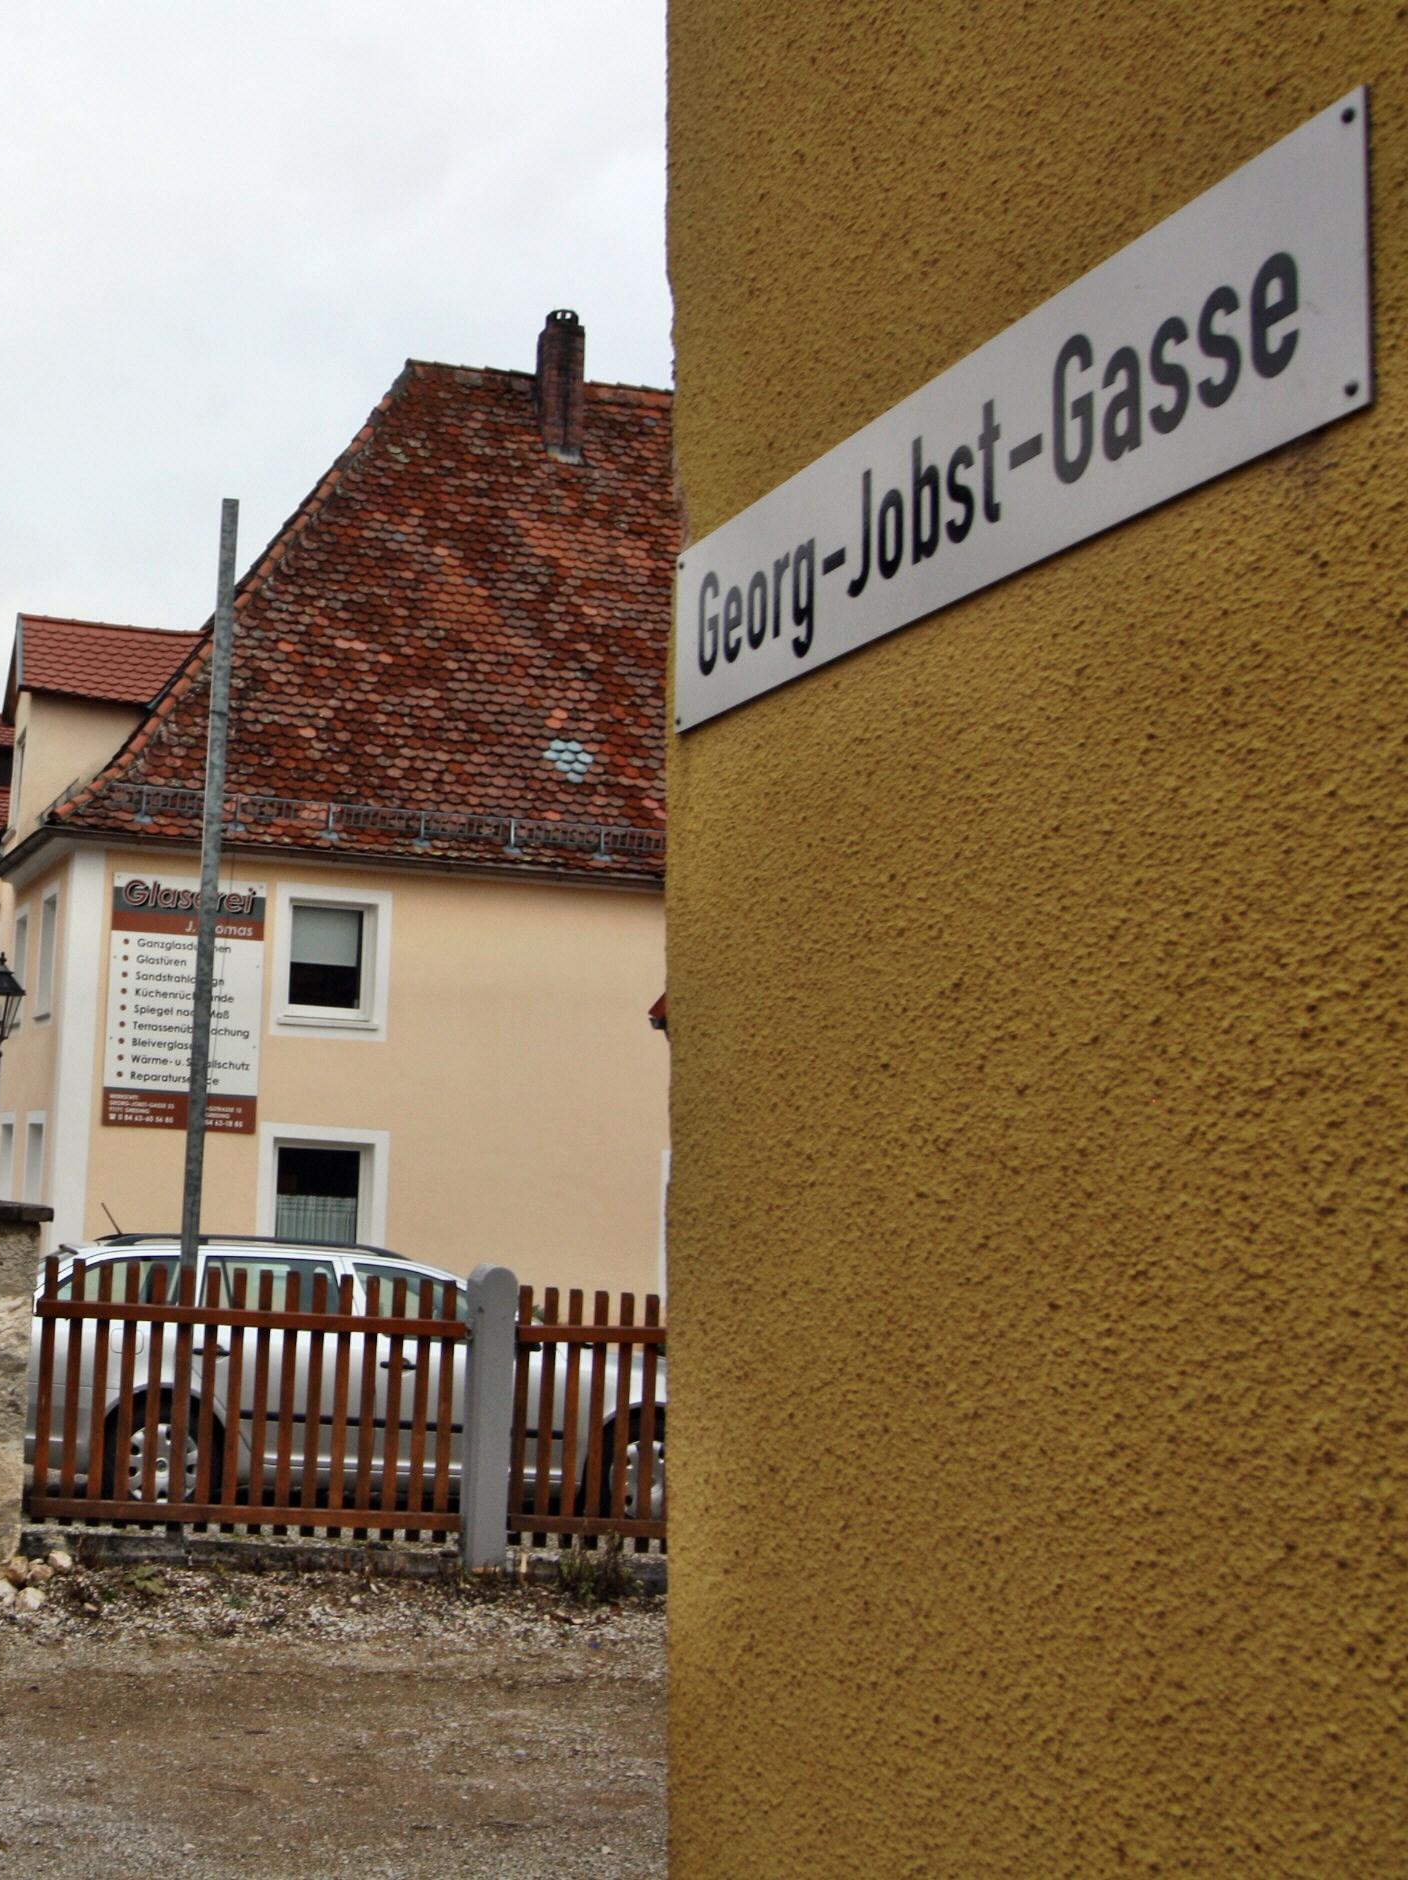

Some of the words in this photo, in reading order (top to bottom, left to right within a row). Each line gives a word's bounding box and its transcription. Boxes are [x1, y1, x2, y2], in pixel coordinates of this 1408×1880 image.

[696, 250, 1300, 676] Georg-Jobst-Gasse
[185, 921, 196, 933] J.
[214, 925, 253, 937] omas
[136, 955, 187, 967] Glastüren
[135, 988, 235, 1003] Küchenrücnde
[134, 1004, 174, 1017] Spiegel
[176, 1008, 193, 1017] nac
[133, 1021, 250, 1040] Terrassenübachung
[131, 1054, 173, 1066] Wärme-
[186, 1059, 250, 1071] Sallschutz
[130, 1071, 220, 1086] Reparatursece
